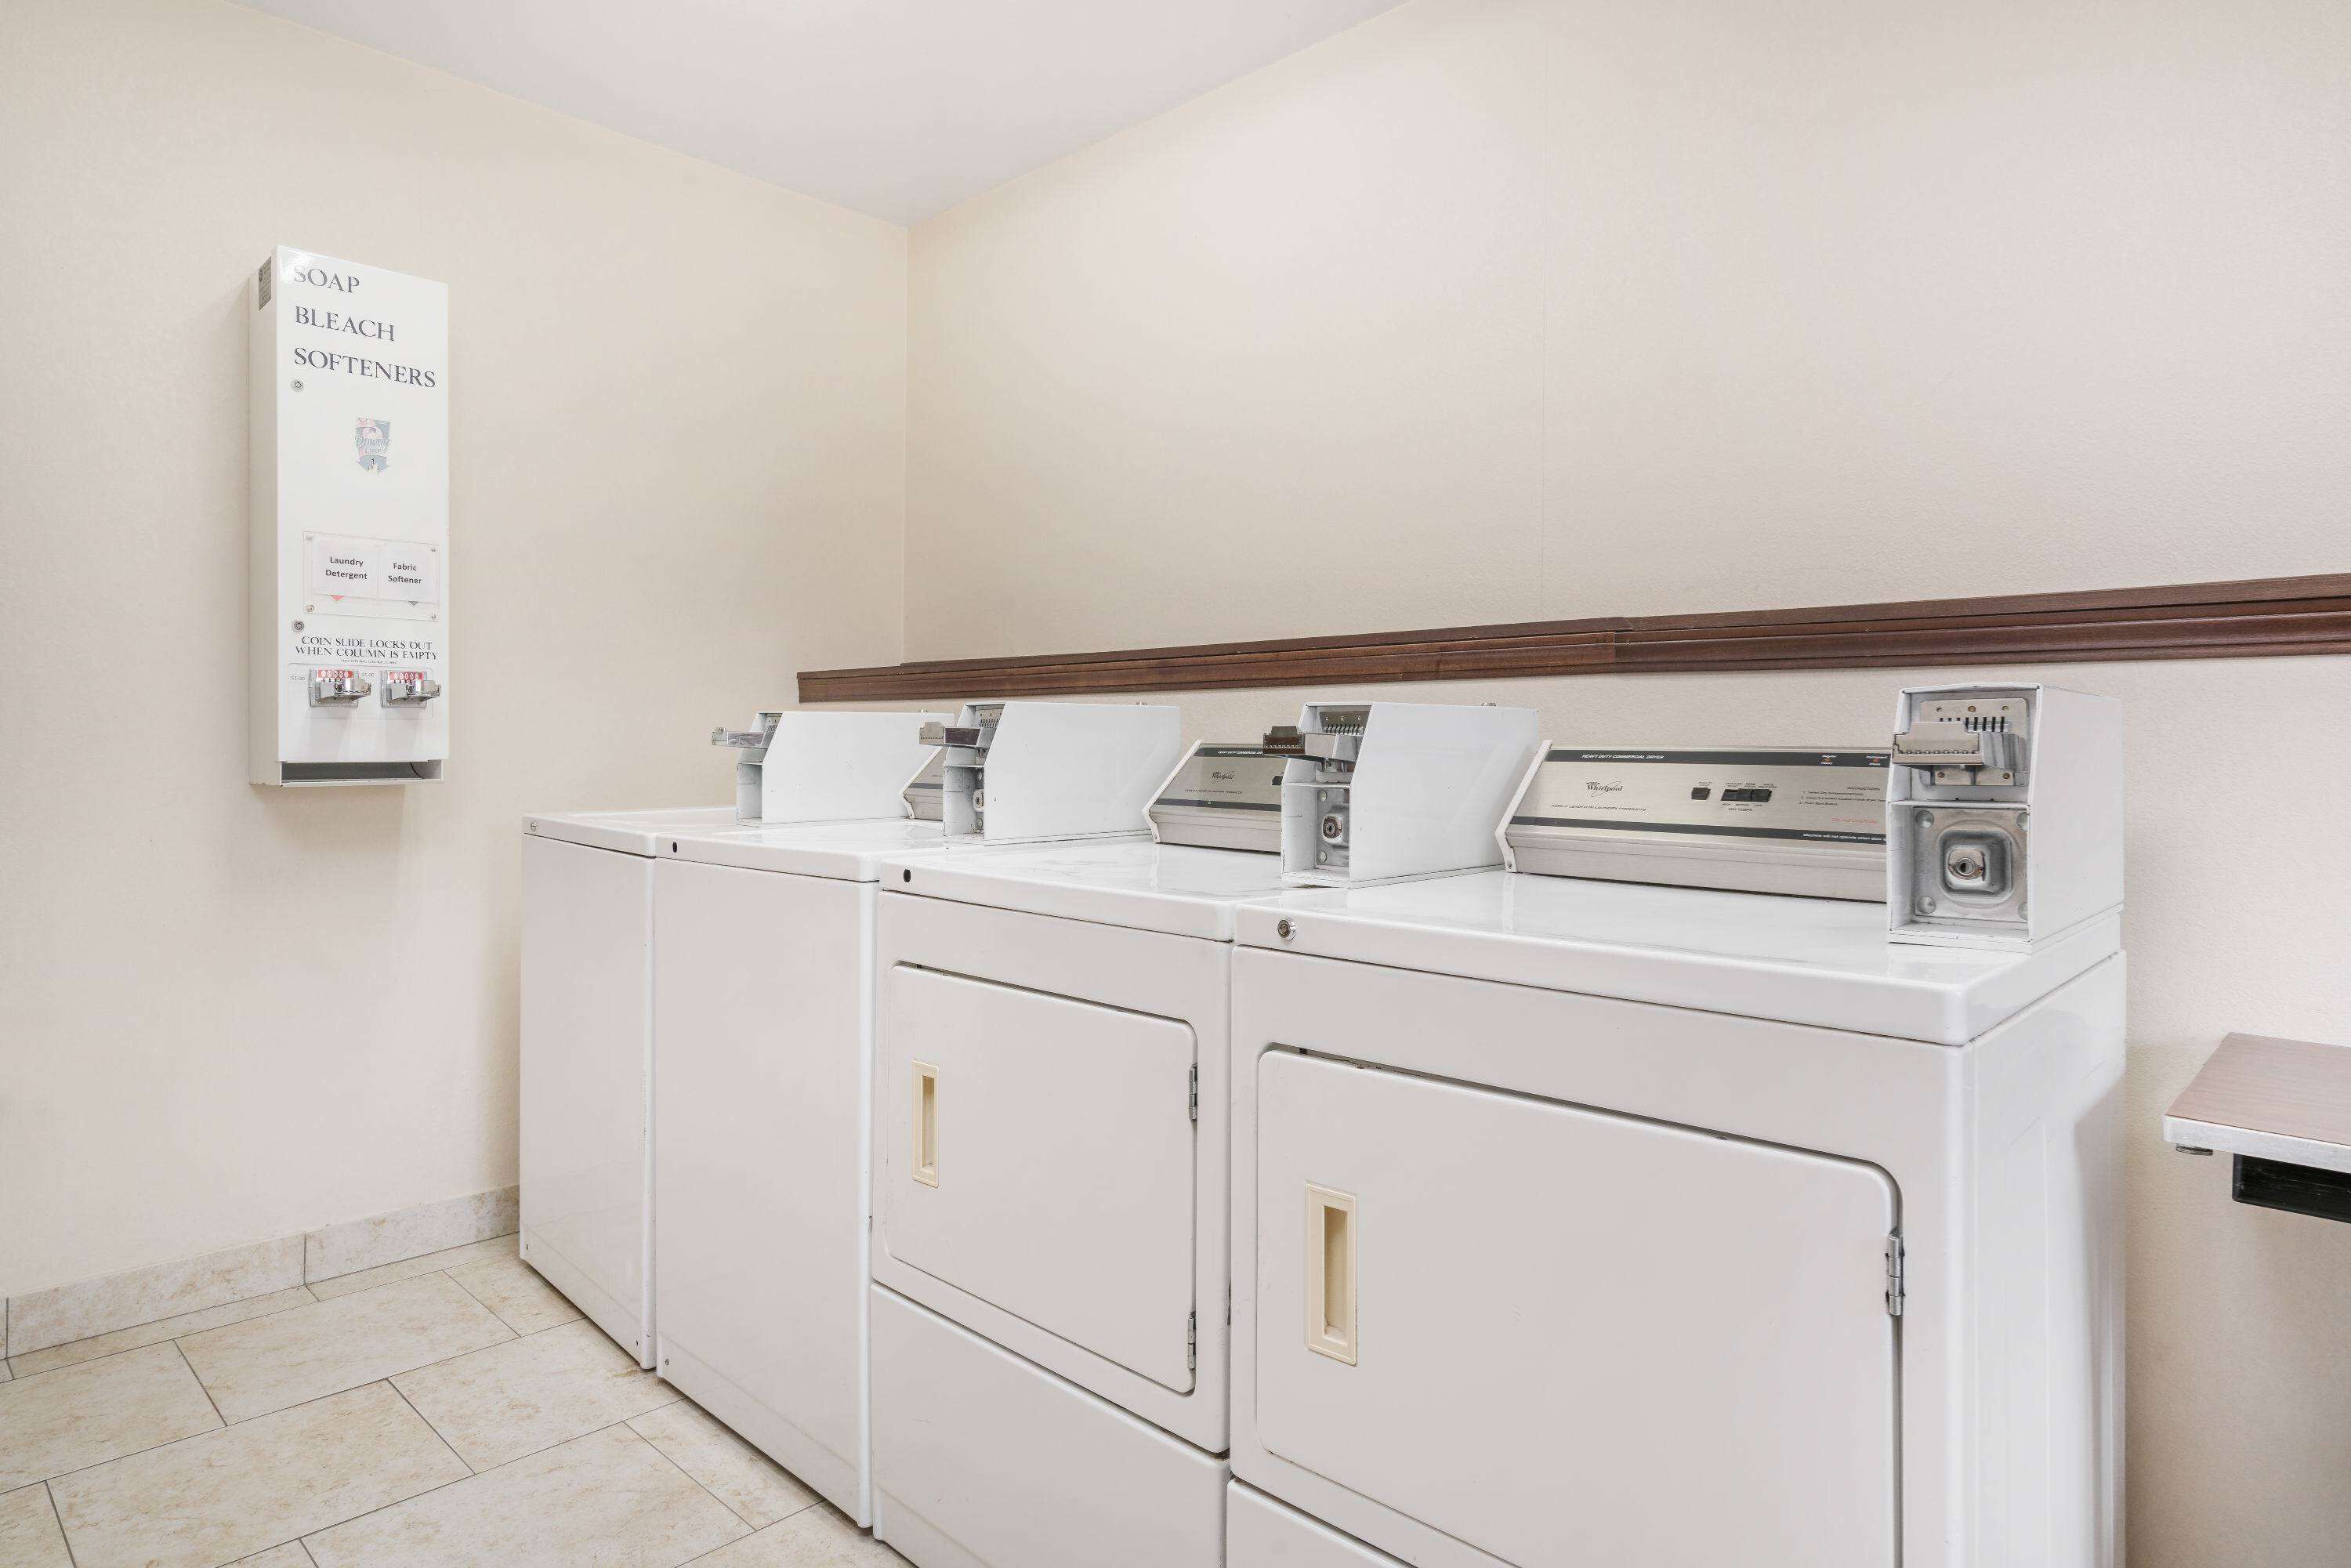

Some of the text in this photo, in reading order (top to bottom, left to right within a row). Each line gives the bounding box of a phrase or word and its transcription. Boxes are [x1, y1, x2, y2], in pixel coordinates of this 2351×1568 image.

[293, 266, 360, 294] SOAP
[294, 305, 395, 342] BLEACH
[293, 346, 437, 388] SOFTENERS
[330, 556, 364, 567] Laundry
[393, 563, 417, 571] Fabric
[325, 570, 368, 580] Detergent
[388, 575, 422, 585] Softener
[301, 636, 433, 650] COIN SLIDE LOCKS OUT
[295, 646, 439, 661] WHEN COLUMN IS EMPTY
